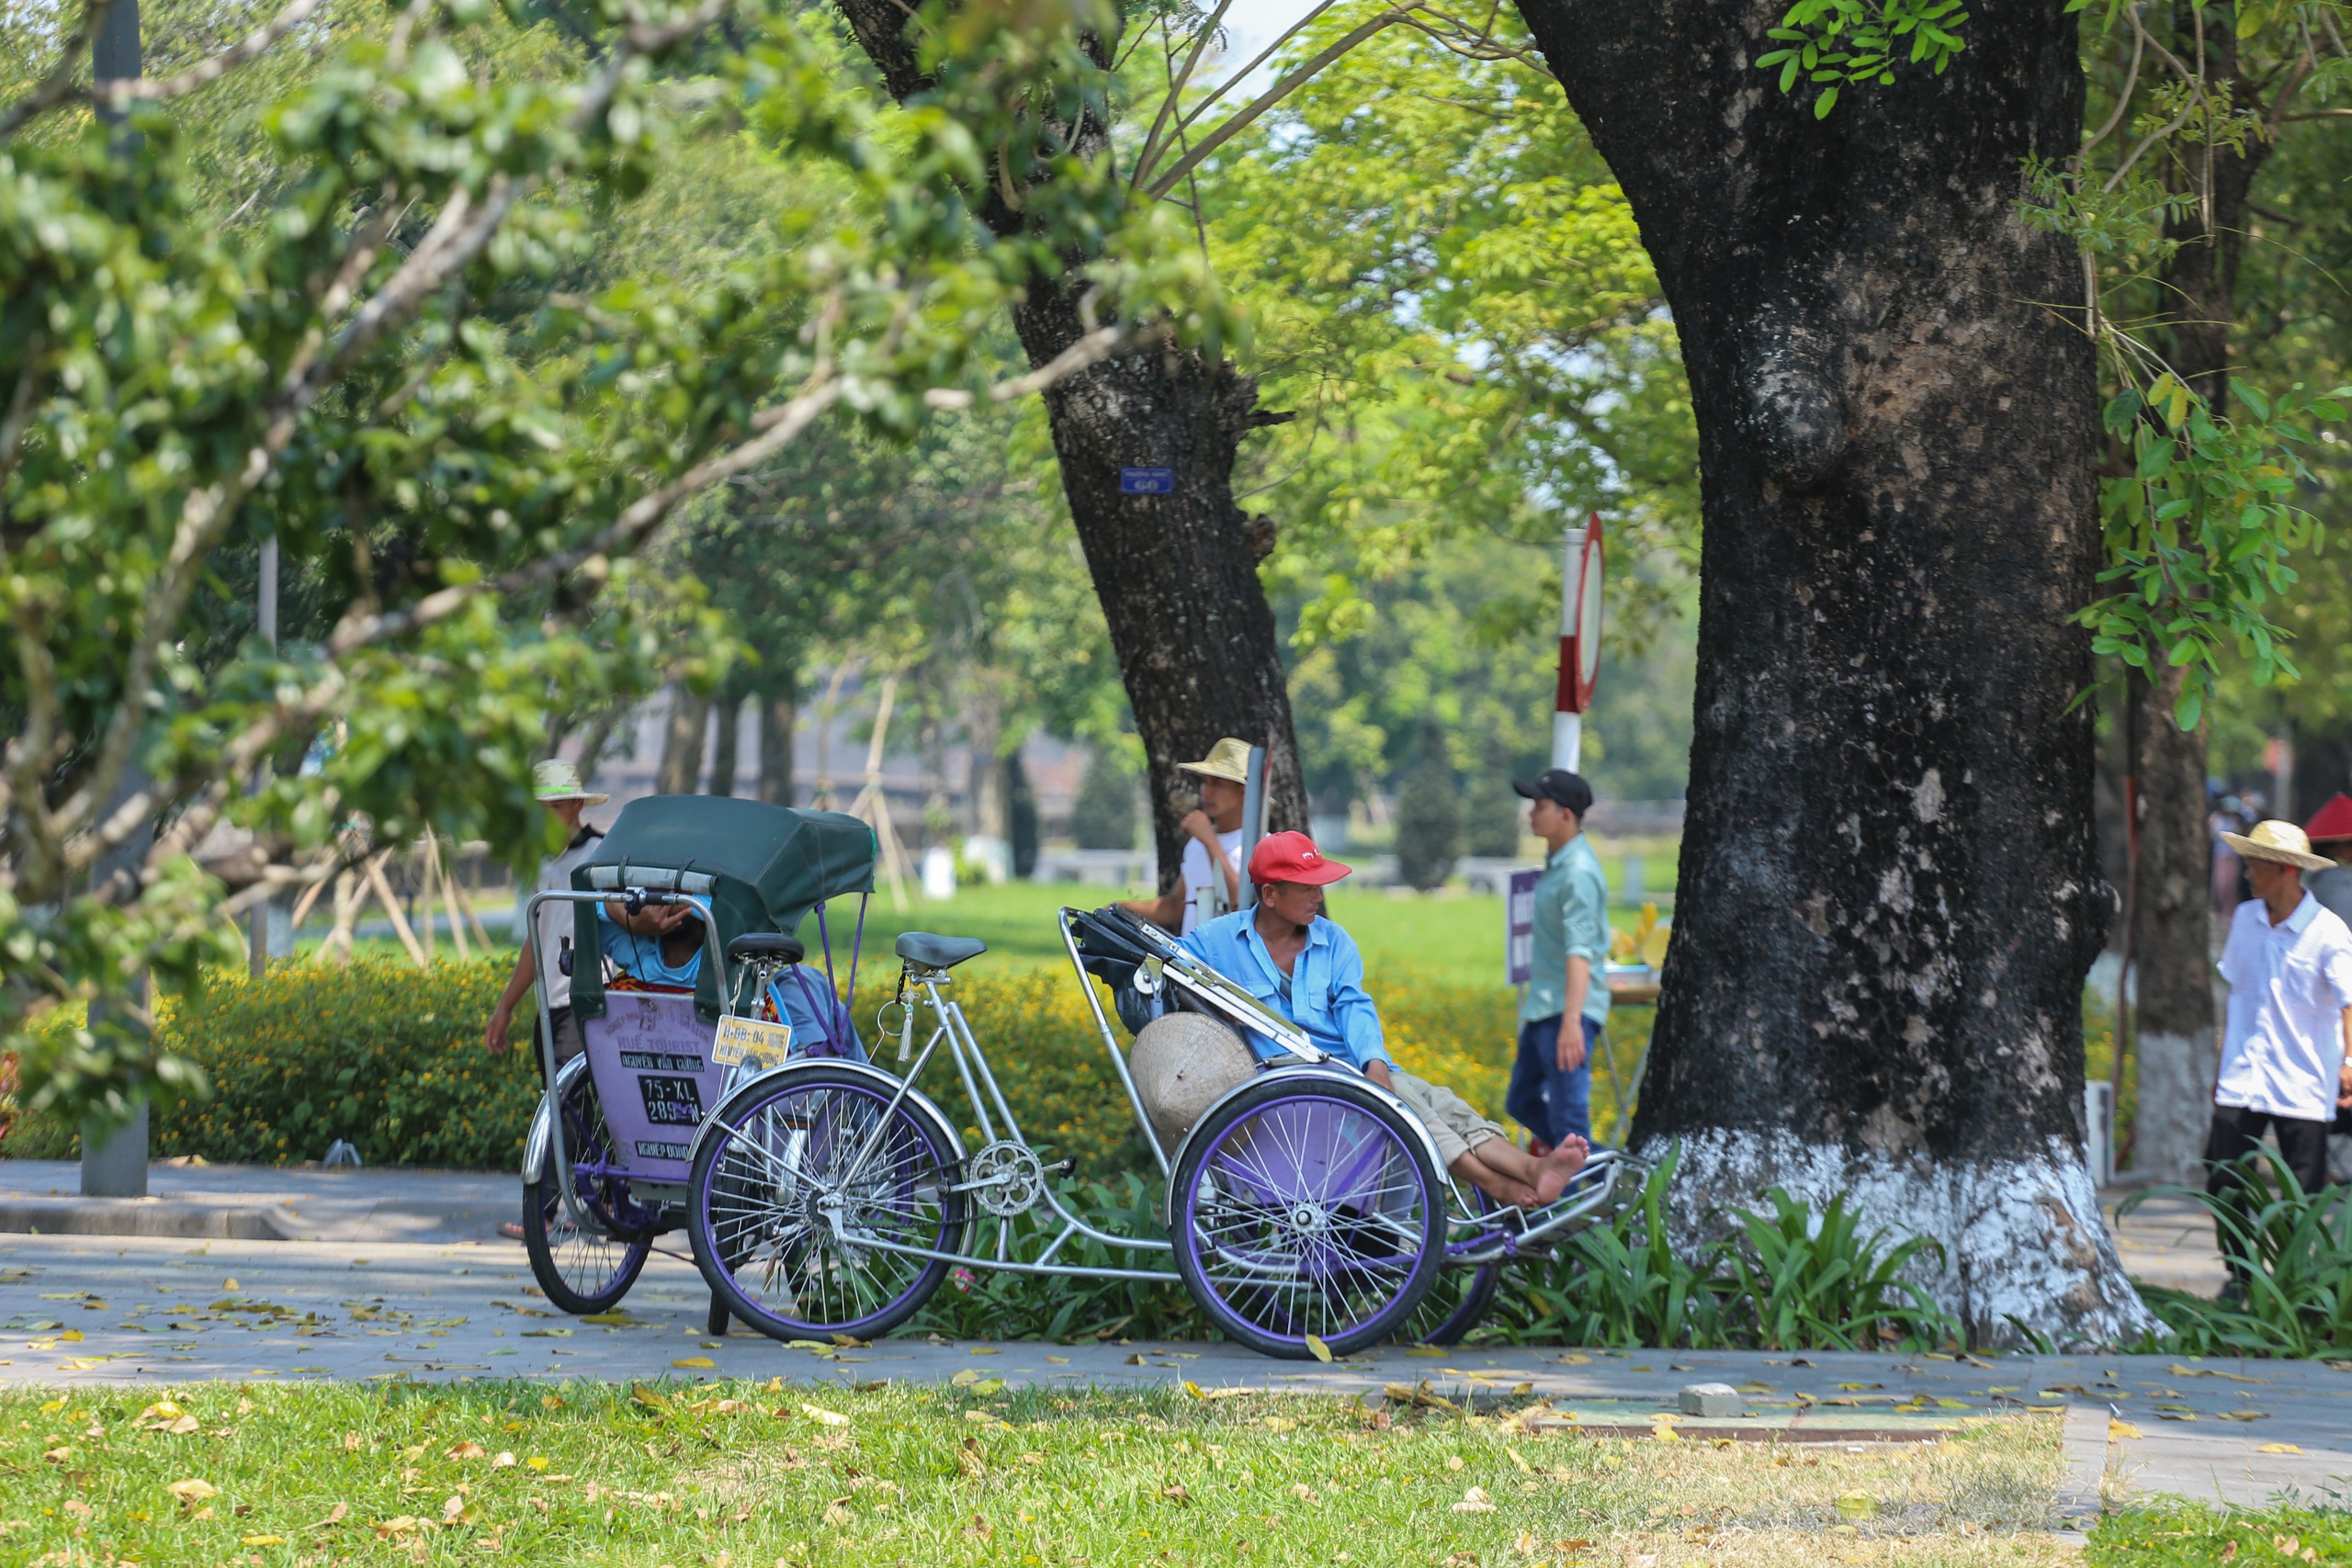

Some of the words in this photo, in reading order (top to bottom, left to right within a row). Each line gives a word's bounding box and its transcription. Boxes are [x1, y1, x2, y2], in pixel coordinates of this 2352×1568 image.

[752, 1031, 764, 1044] 04
[647, 1039, 699, 1054] TOURIST
[645, 1079, 695, 1100] 75-XL
